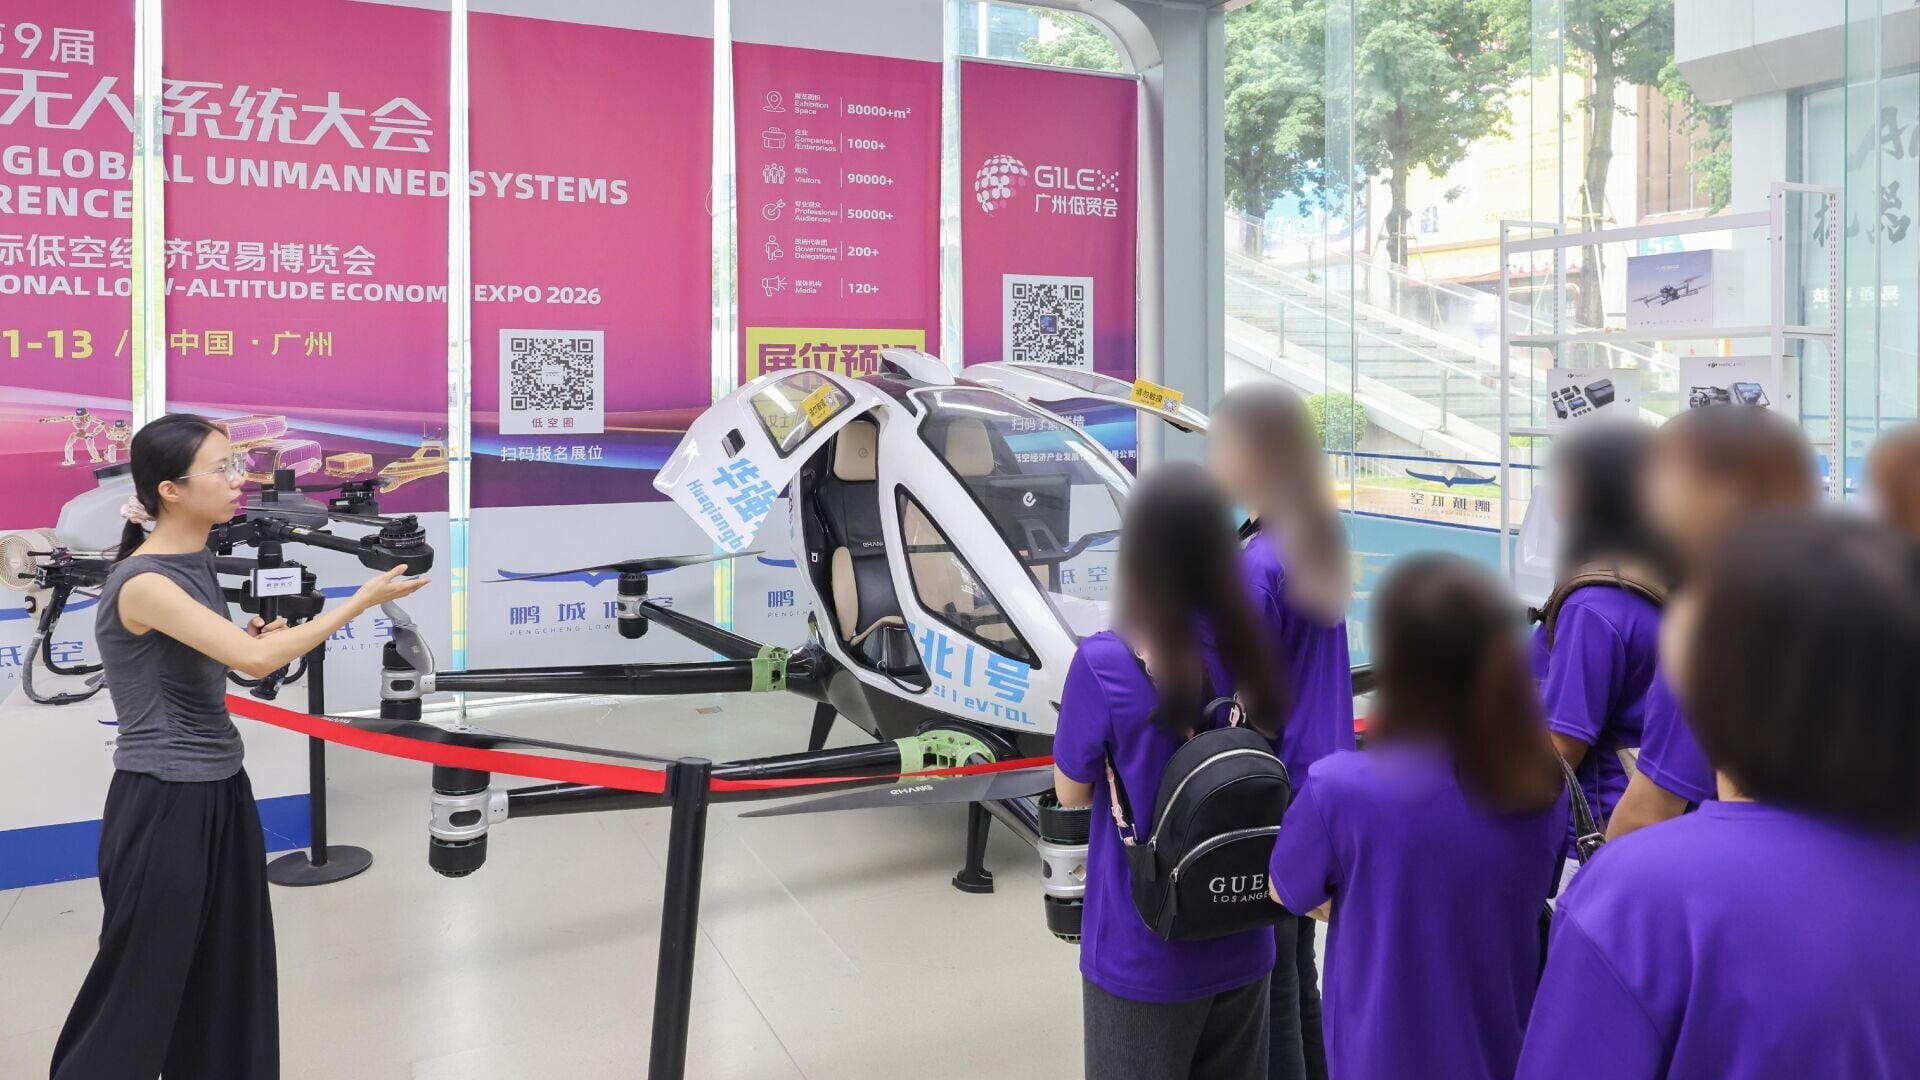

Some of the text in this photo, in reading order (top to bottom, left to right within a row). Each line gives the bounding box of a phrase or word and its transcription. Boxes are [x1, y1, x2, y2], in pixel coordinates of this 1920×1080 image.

[794, 100, 829, 110] Exhibition
[794, 107, 817, 116] Space
[794, 135, 834, 146] Companies
[847, 138, 886, 150] 1000+
[206, 156, 449, 197] UNMANNED
[469, 170, 628, 206] SYSTEMS
[794, 176, 821, 185] Visitors
[847, 173, 894, 186] 90000+
[1034, 193, 1118, 217] 广州低贸会
[794, 208, 838, 217] Professional
[847, 208, 894, 221] 50000+
[794, 215, 831, 223] Audiences
[794, 245, 838, 254] Government
[847, 246, 880, 257] 200+
[794, 252, 836, 261] Delegations
[332, 283, 447, 302] ECONOM
[475, 285, 542, 302] EXPO
[546, 287, 602, 305] 2026
[847, 282, 880, 294] 120+
[500, 445, 603, 462] 扫码报名展位
[1209, 874, 1264, 893] GUE
[1213, 891, 1269, 903] LOS ANGE
